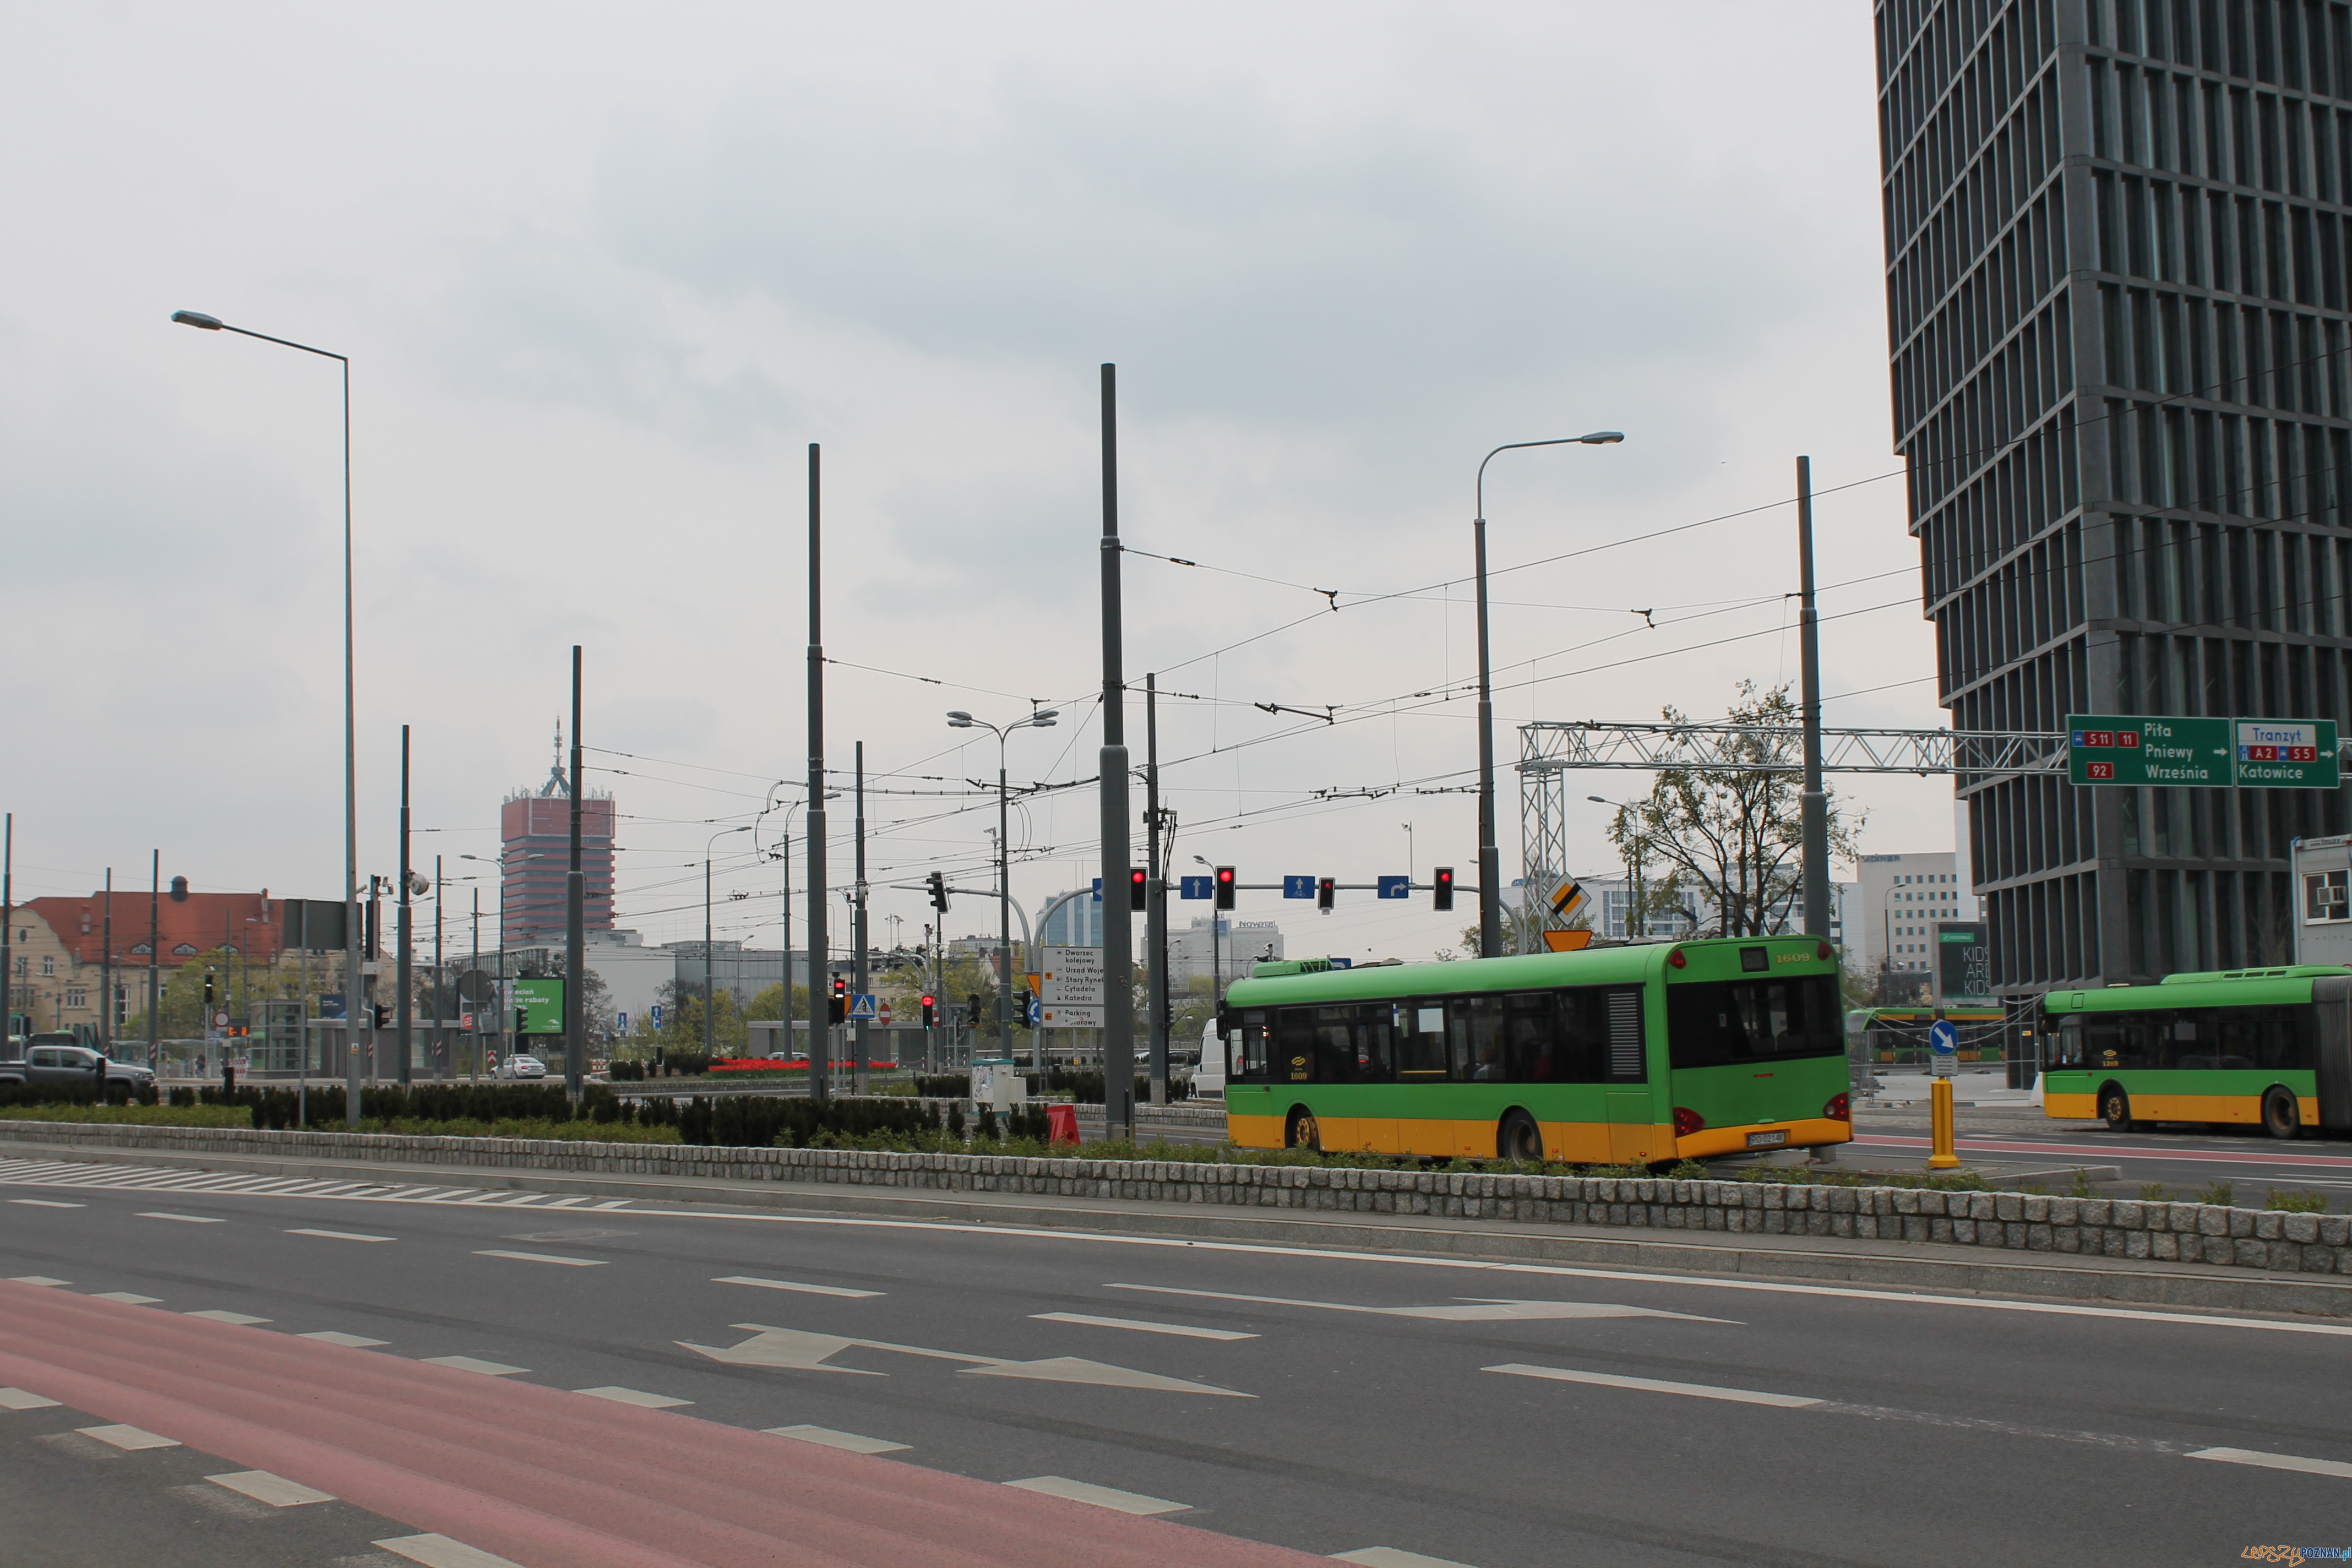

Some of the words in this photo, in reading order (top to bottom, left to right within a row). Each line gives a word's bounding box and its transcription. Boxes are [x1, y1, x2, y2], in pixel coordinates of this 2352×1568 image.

[2144, 722, 2171, 737] Piła
[2090, 733, 2097, 744] S
[2100, 733, 2109, 744] 11
[2123, 734, 2132, 745] 11
[2252, 727, 2301, 745] Tranzyt
[2146, 743, 2193, 762] Pniewy
[2255, 748, 2263, 758] A
[2266, 748, 2272, 758] 2
[2294, 748, 2300, 759] S
[2304, 748, 2310, 759] 5
[2093, 765, 2106, 776] 92
[2145, 764, 2209, 779] Września
[2239, 764, 2304, 779] Katowice
[1776, 953, 1811, 963] 1609
[1064, 985, 1096, 993] Cytadela
